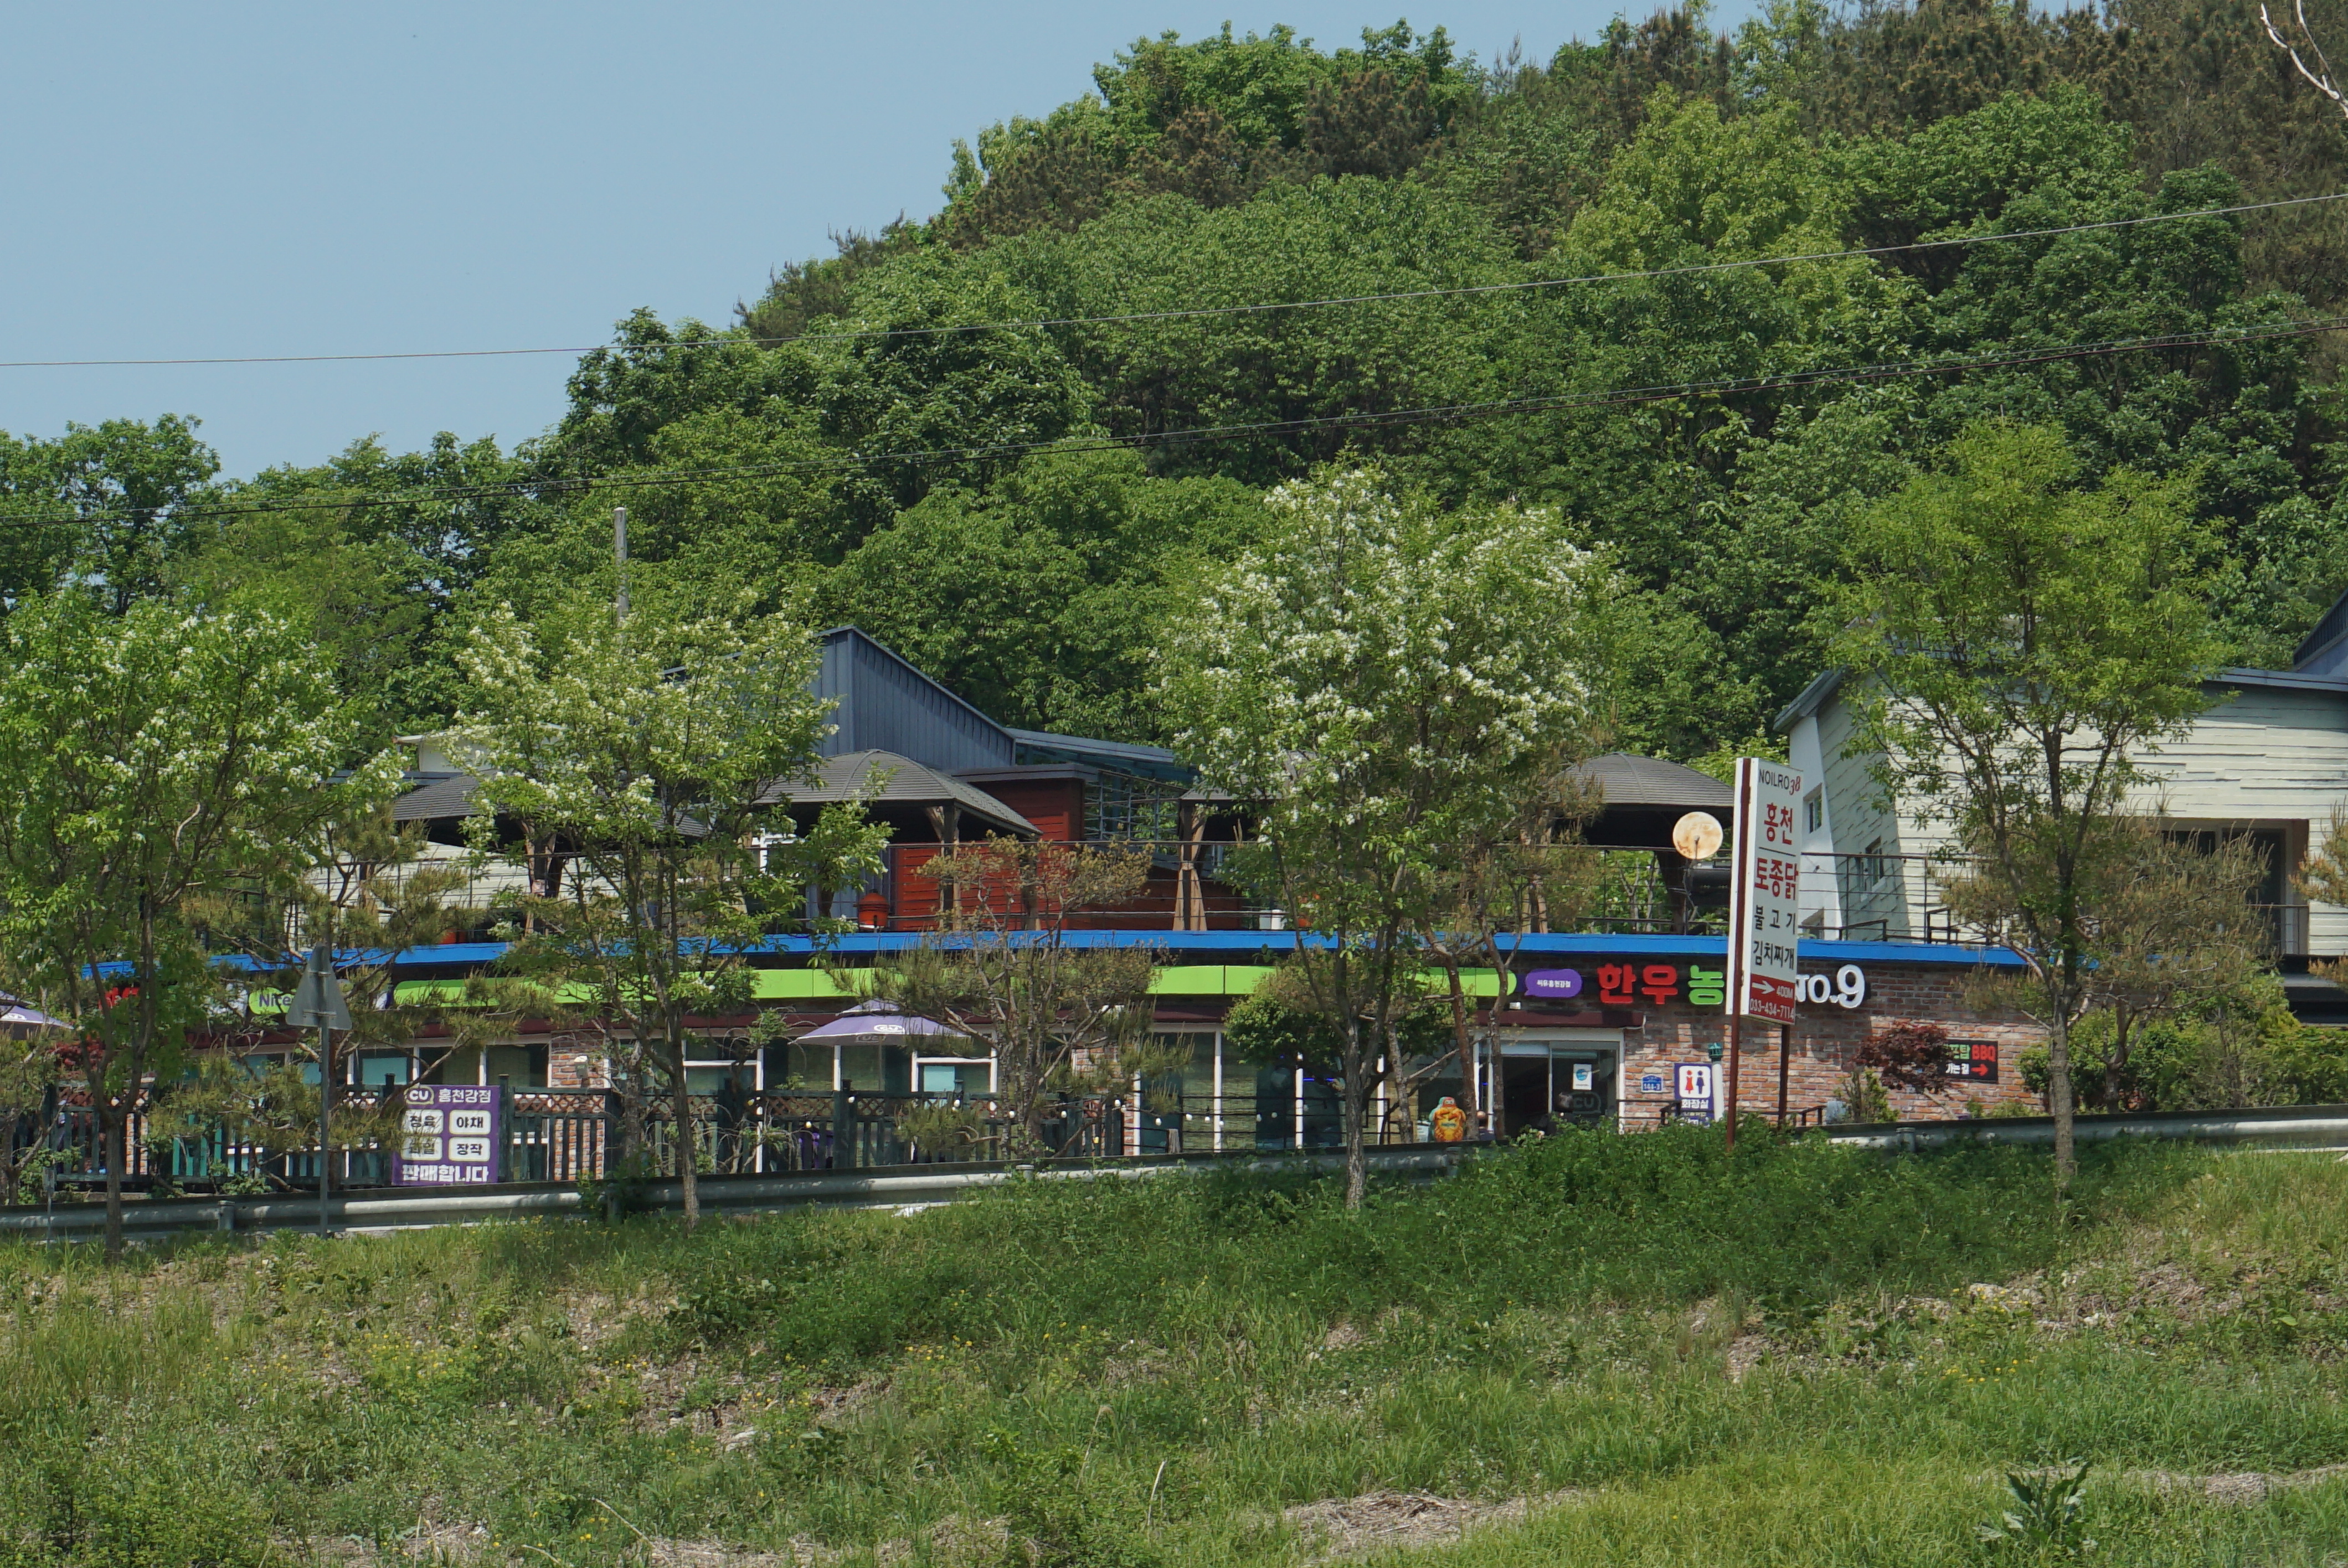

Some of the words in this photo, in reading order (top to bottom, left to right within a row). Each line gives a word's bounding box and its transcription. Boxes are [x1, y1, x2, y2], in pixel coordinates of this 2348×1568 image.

[1764, 802, 1793, 845] 홍천
[1754, 857, 1799, 900] 토종닭
[1754, 904, 1796, 935] 불고기
[1753, 940, 1795, 970] 김치찌개
[1972, 1044, 1996, 1062] BBQ
[409, 1089, 429, 1101] CU
[439, 1088, 491, 1103] 홍천강점
[1681, 1098, 1709, 1109] 화장실
[456, 1116, 483, 1128] 야채
[457, 1143, 483, 1156] 장작
[402, 1164, 489, 1183] 판매합니다
